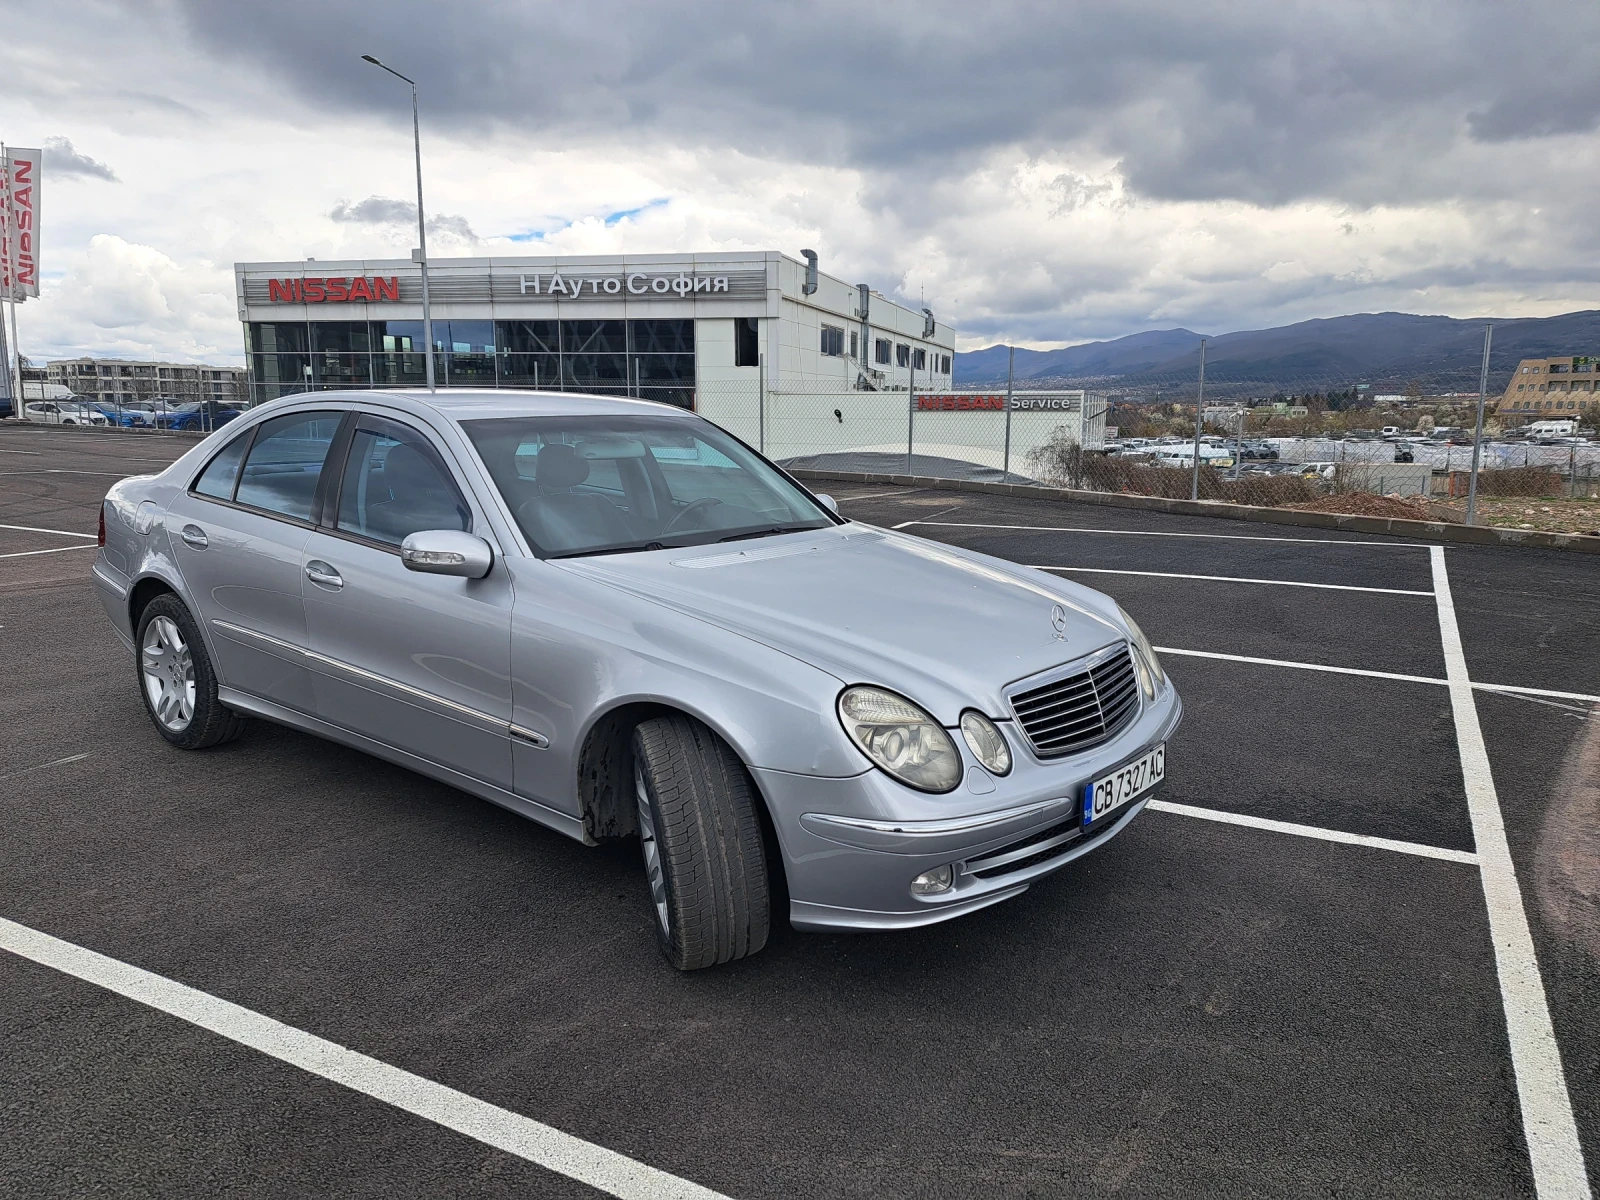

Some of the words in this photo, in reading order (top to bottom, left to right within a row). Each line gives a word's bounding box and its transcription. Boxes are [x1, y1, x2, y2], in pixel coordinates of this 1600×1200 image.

[13, 160, 34, 286] NISSAN
[268, 276, 399, 303] NISSAN
[519, 274, 540, 294] Н
[547, 273, 621, 299] Ауто
[627, 271, 729, 298] София
[918, 395, 1004, 411] NISSAN
[1010, 396, 1071, 409] Service
[1094, 779, 1113, 815] CB
[1116, 759, 1147, 804] 7327
[1149, 749, 1163, 783] AC
